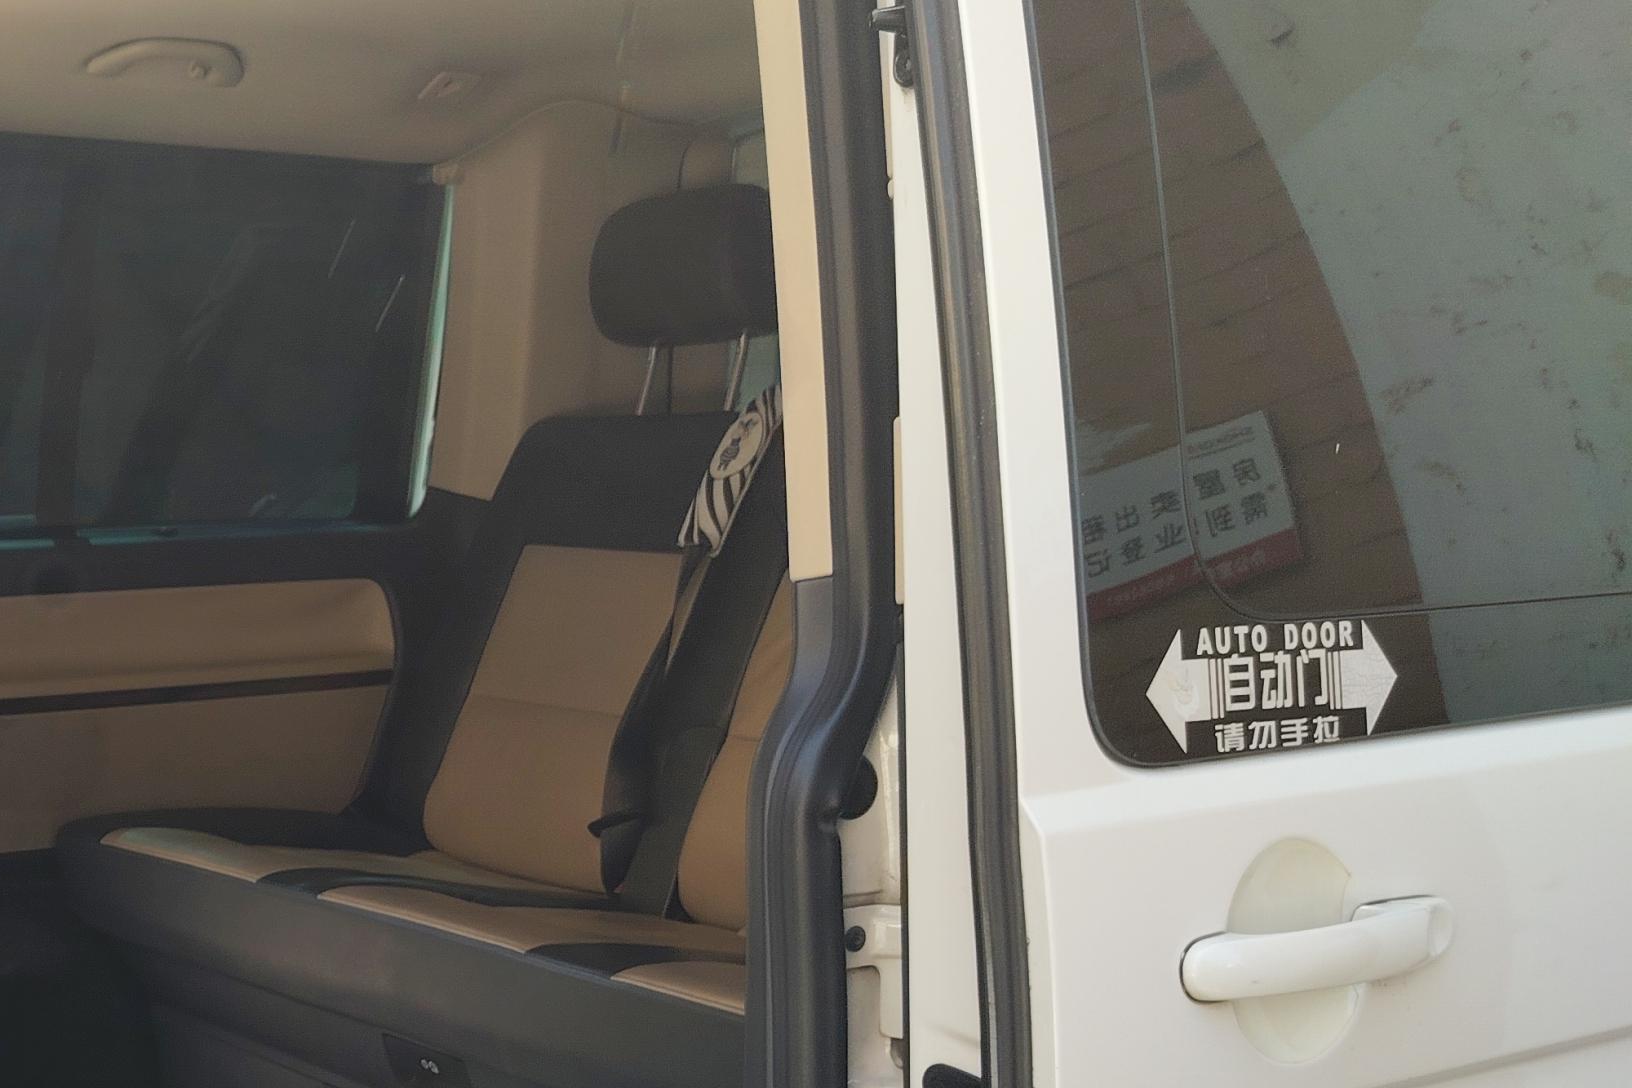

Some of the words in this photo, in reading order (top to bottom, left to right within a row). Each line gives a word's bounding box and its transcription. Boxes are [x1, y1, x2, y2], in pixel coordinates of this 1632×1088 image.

[1196, 624, 1268, 656] AUTO
[1283, 620, 1354, 650] DOOR
[1223, 648, 1329, 712] 自动门
[1214, 715, 1341, 753] 请勿手拉
